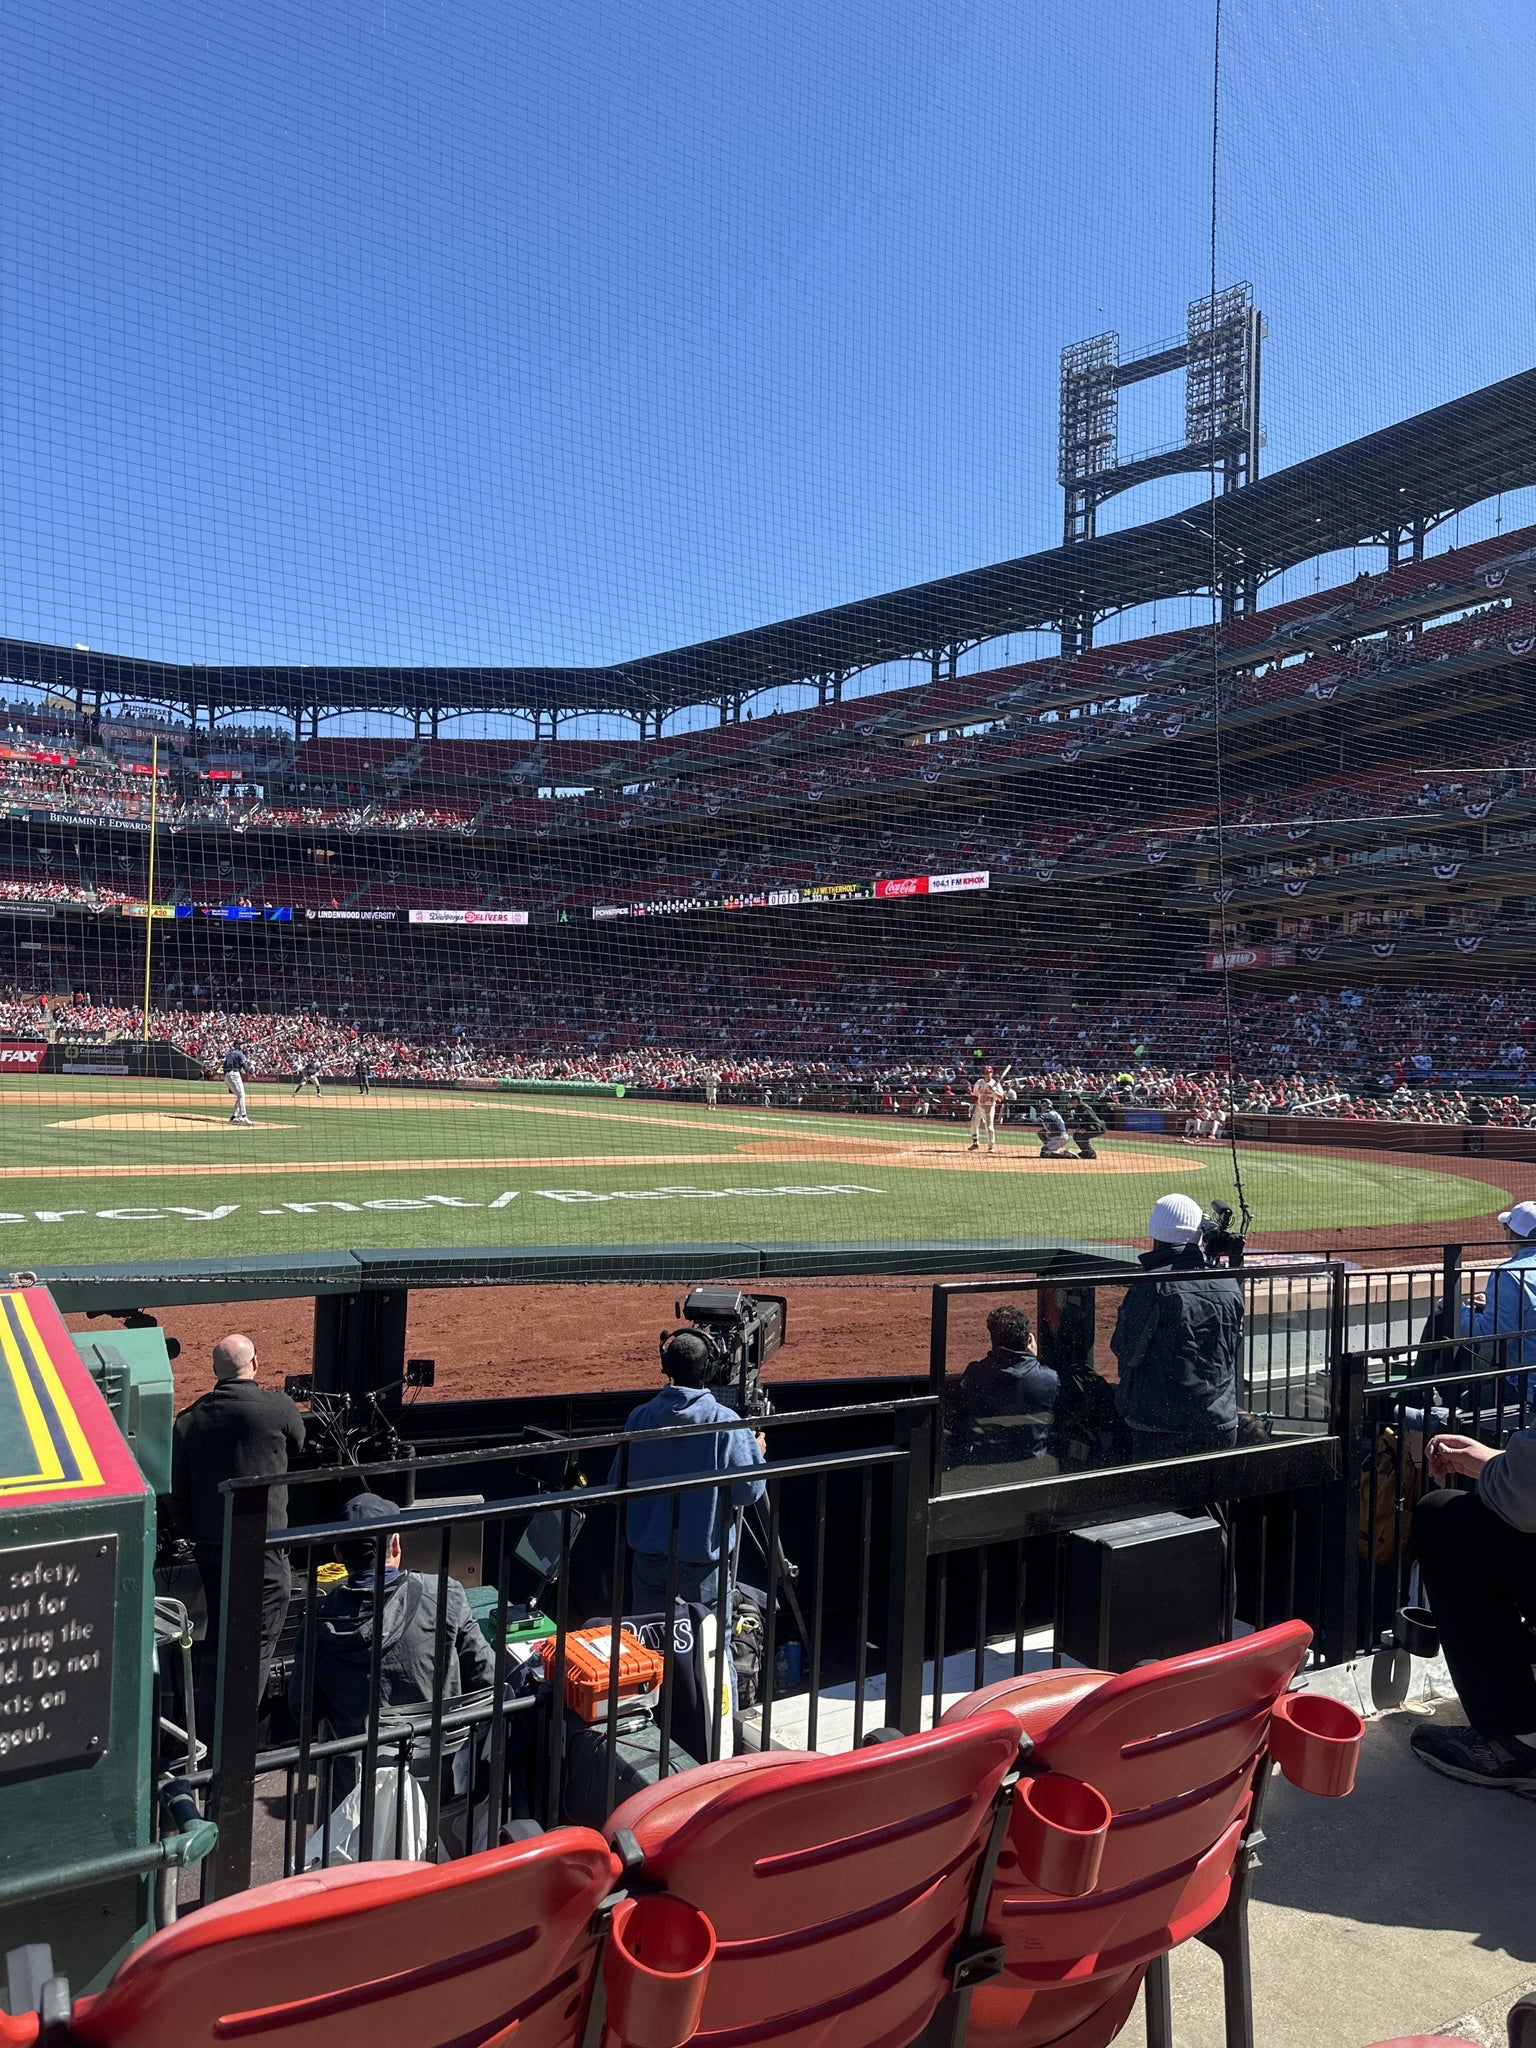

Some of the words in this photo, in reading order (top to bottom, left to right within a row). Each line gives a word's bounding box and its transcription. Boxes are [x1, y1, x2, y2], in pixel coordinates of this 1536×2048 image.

[50, 813, 96, 825] BENJAMIN
[99, 818, 106, 826] F.
[109, 819, 152, 831] EDWARDS
[820, 884, 856, 894] WETHERHOLT
[932, 880, 949, 888] 104.1
[963, 876, 985, 885] KMOX
[318, 910, 360, 918] LINDENWOOD
[10, 1561, 80, 1588] safety,
[39, 1592, 68, 1615] for
[62, 1619, 94, 1643] the
[33, 1656, 60, 1680] Do
[68, 1650, 100, 1674] not
[41, 1689, 66, 1709] on
